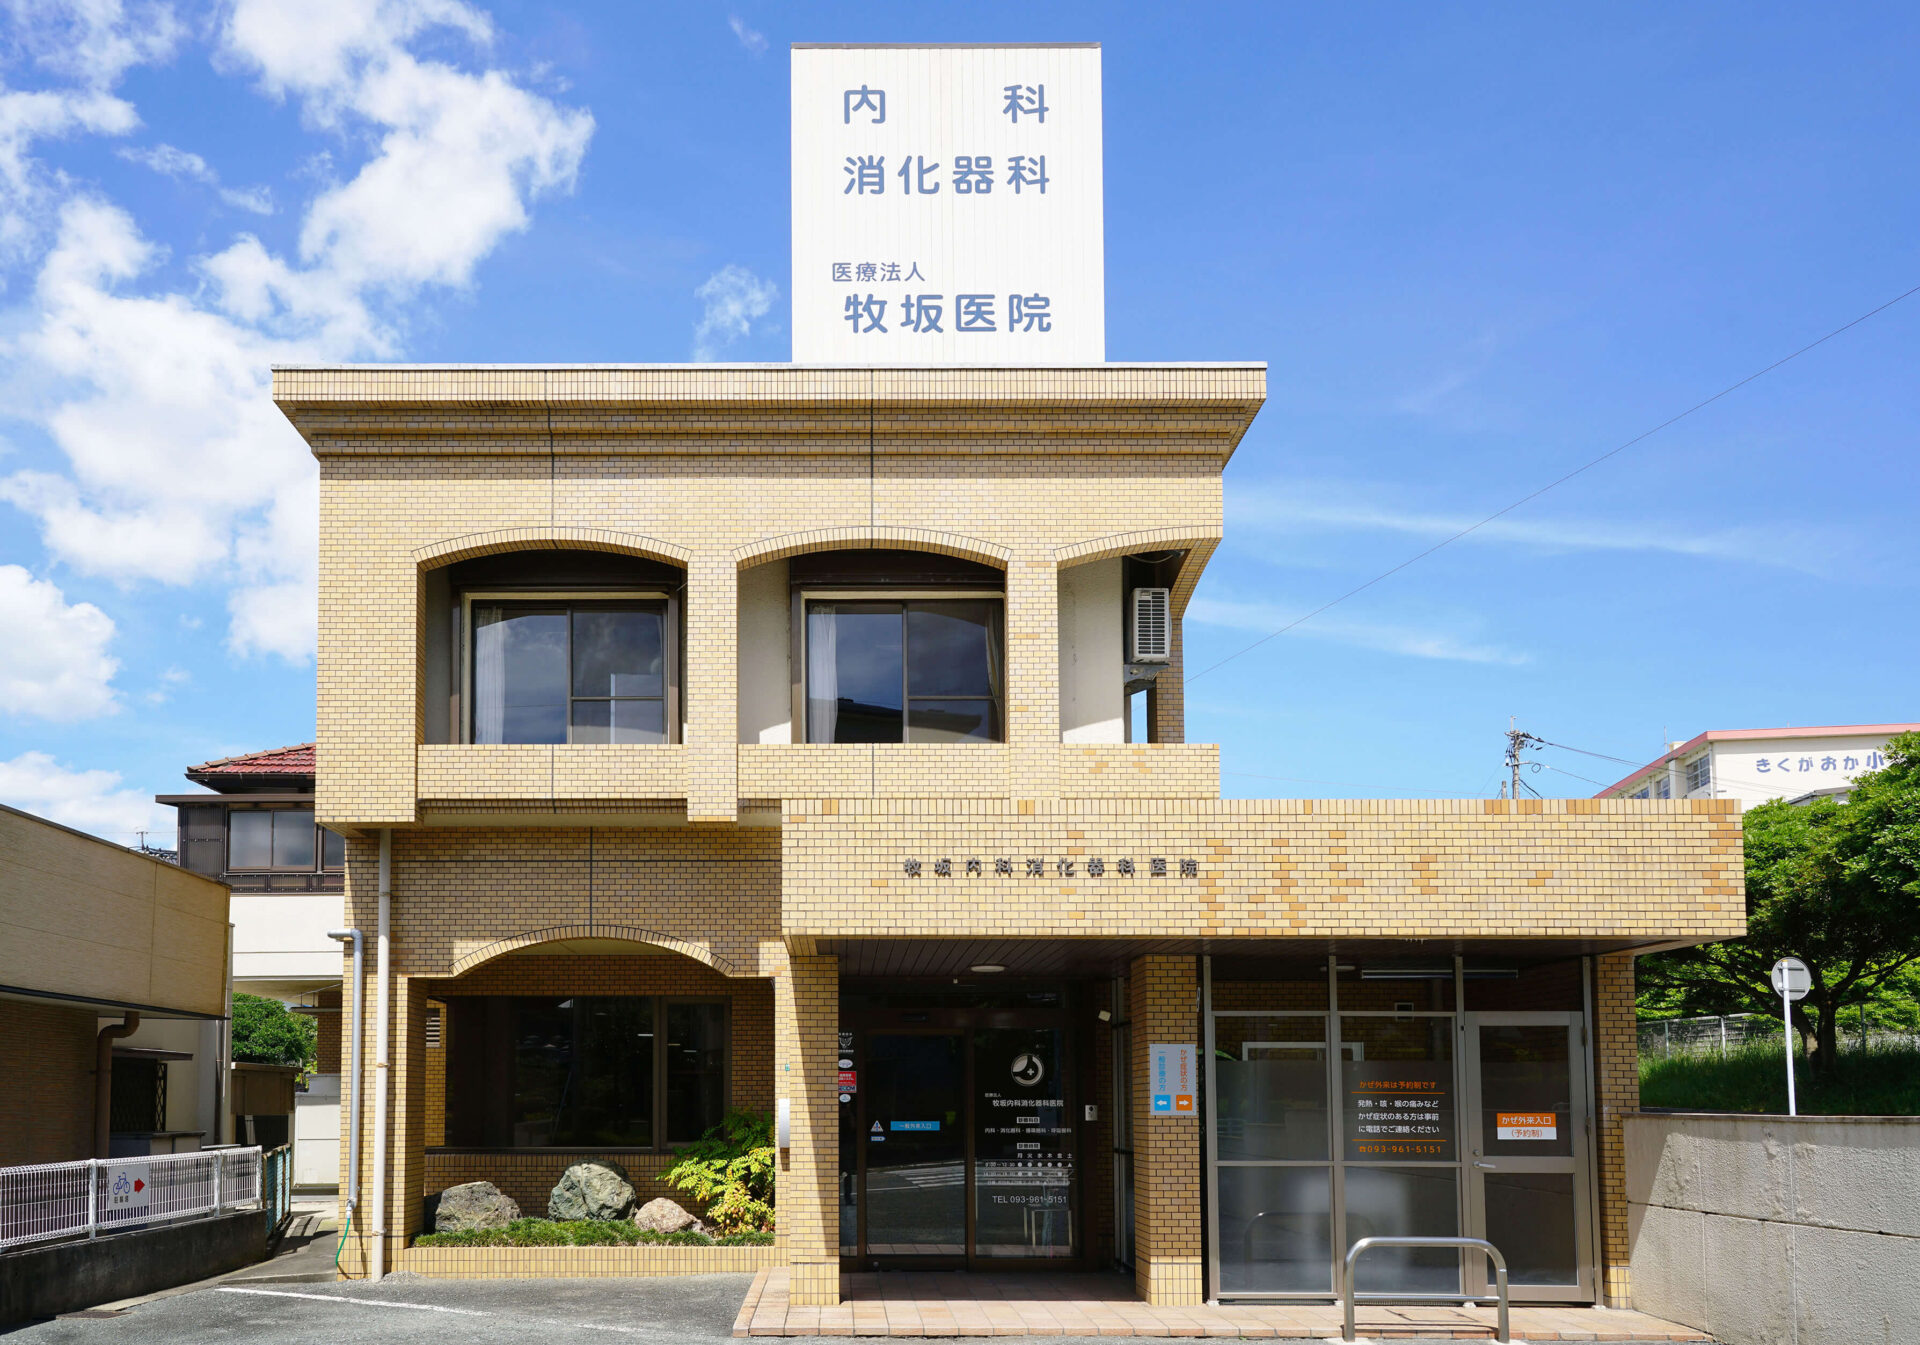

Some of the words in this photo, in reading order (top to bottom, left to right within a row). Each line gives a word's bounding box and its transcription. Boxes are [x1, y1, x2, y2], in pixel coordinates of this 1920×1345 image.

[843, 155, 1050, 195] 消化器科
[832, 261, 926, 282] 医療法人
[844, 293, 1052, 334] 牧坂医院
[1756, 751, 1885, 773] きくがおか小
[904, 857, 1198, 878] 牧坂内科消化器科医院
[1180, 1049, 1188, 1092] かぜ症状の方
[1359, 1081, 1436, 1089] かぜ外来は予約制です
[992, 1099, 1064, 1107] 牧坂内科消化器科医院
[1357, 1099, 1439, 1108] 発熱・咳・喉の痛みなど
[1358, 1112, 1440, 1121] かぜ症状のある方は事前
[1502, 1116, 1552, 1125] かぜ外来入口
[1358, 1125, 1440, 1134] に電話でご連絡ください
[992, 1195, 1008, 1204] TEL
[1010, 1195, 1067, 1204] 093-961-5151
